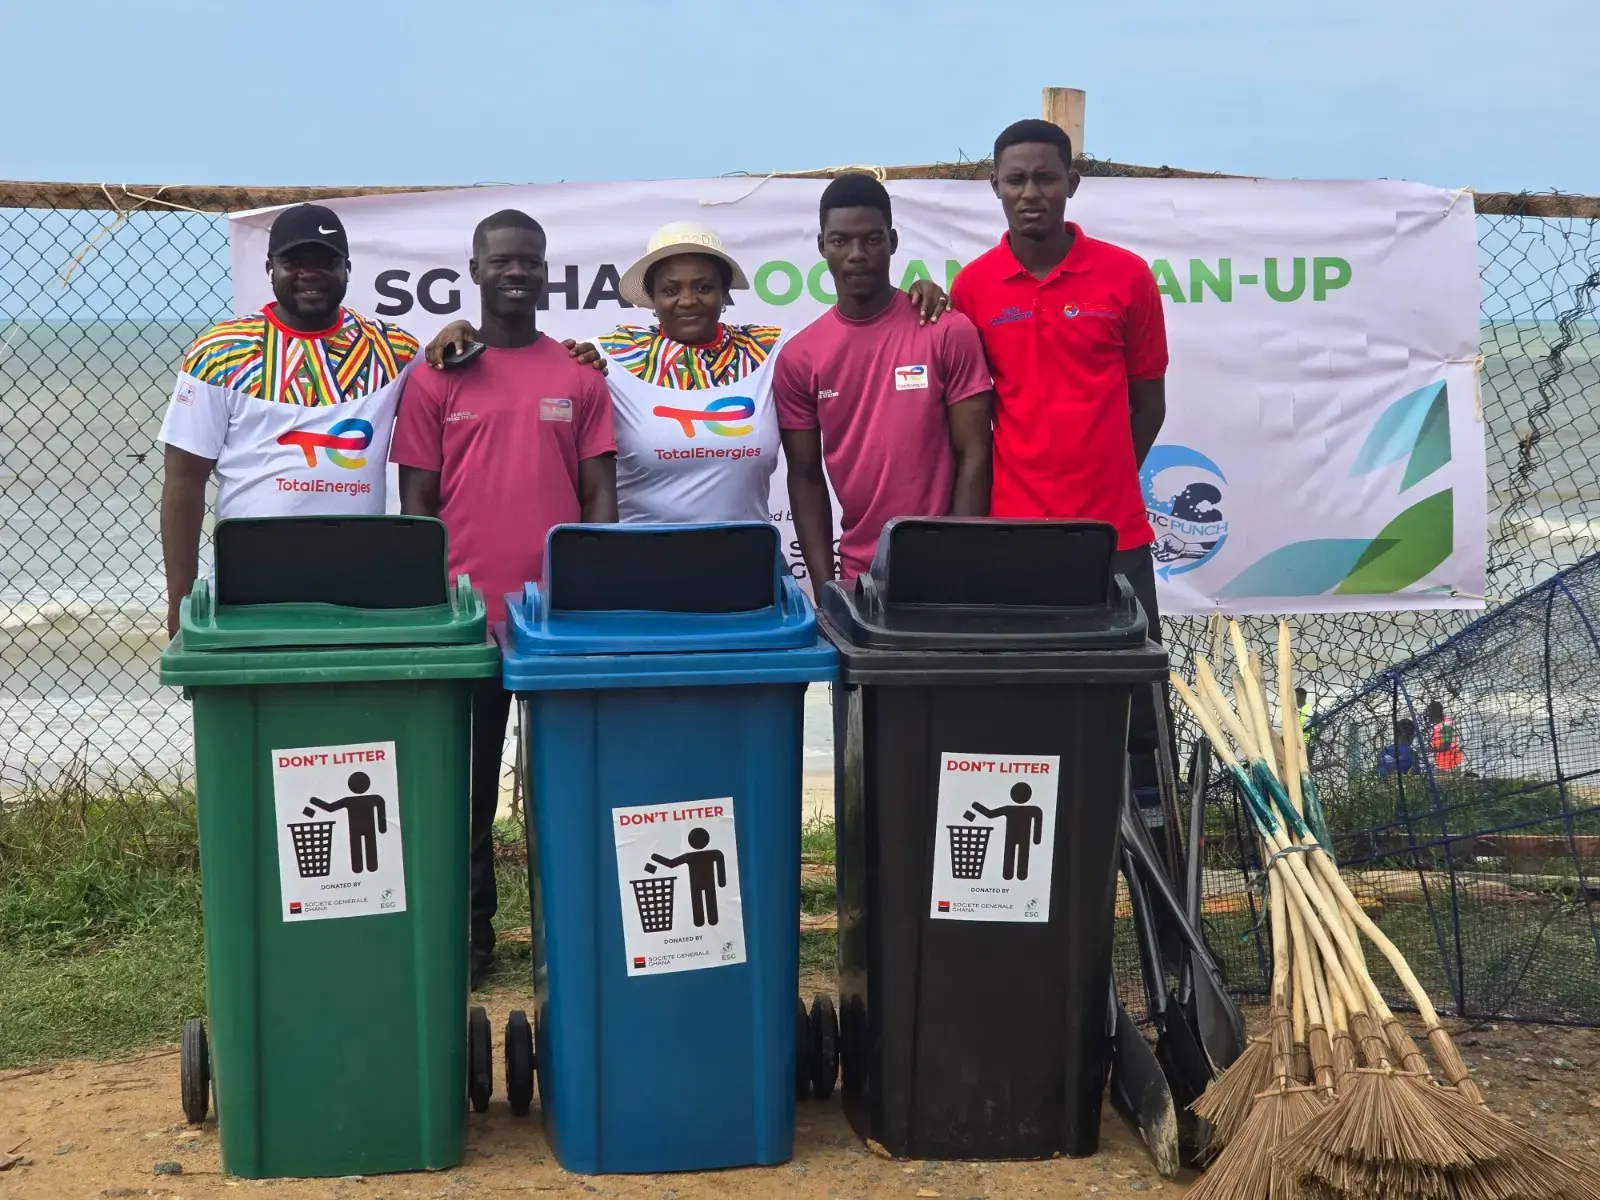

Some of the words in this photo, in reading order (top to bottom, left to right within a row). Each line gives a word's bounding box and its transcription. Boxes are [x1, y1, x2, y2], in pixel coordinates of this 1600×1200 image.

[375, 268, 461, 316] SG
[1150, 257, 1352, 303] AN-UP
[654, 446, 761, 460] TotalEnergies
[276, 478, 370, 496] TotalEnergies
[1171, 520, 1229, 536] PUNCH
[278, 754, 328, 768] DON'T
[333, 750, 386, 765] LITTER
[947, 760, 996, 773] DON'T
[1000, 762, 1050, 774] LITTER
[619, 811, 669, 826] DON'T
[673, 806, 724, 821] LITTER
[321, 882, 352, 890] DONATED
[663, 936, 694, 944] DONATED
[721, 953, 736, 961] ESG
